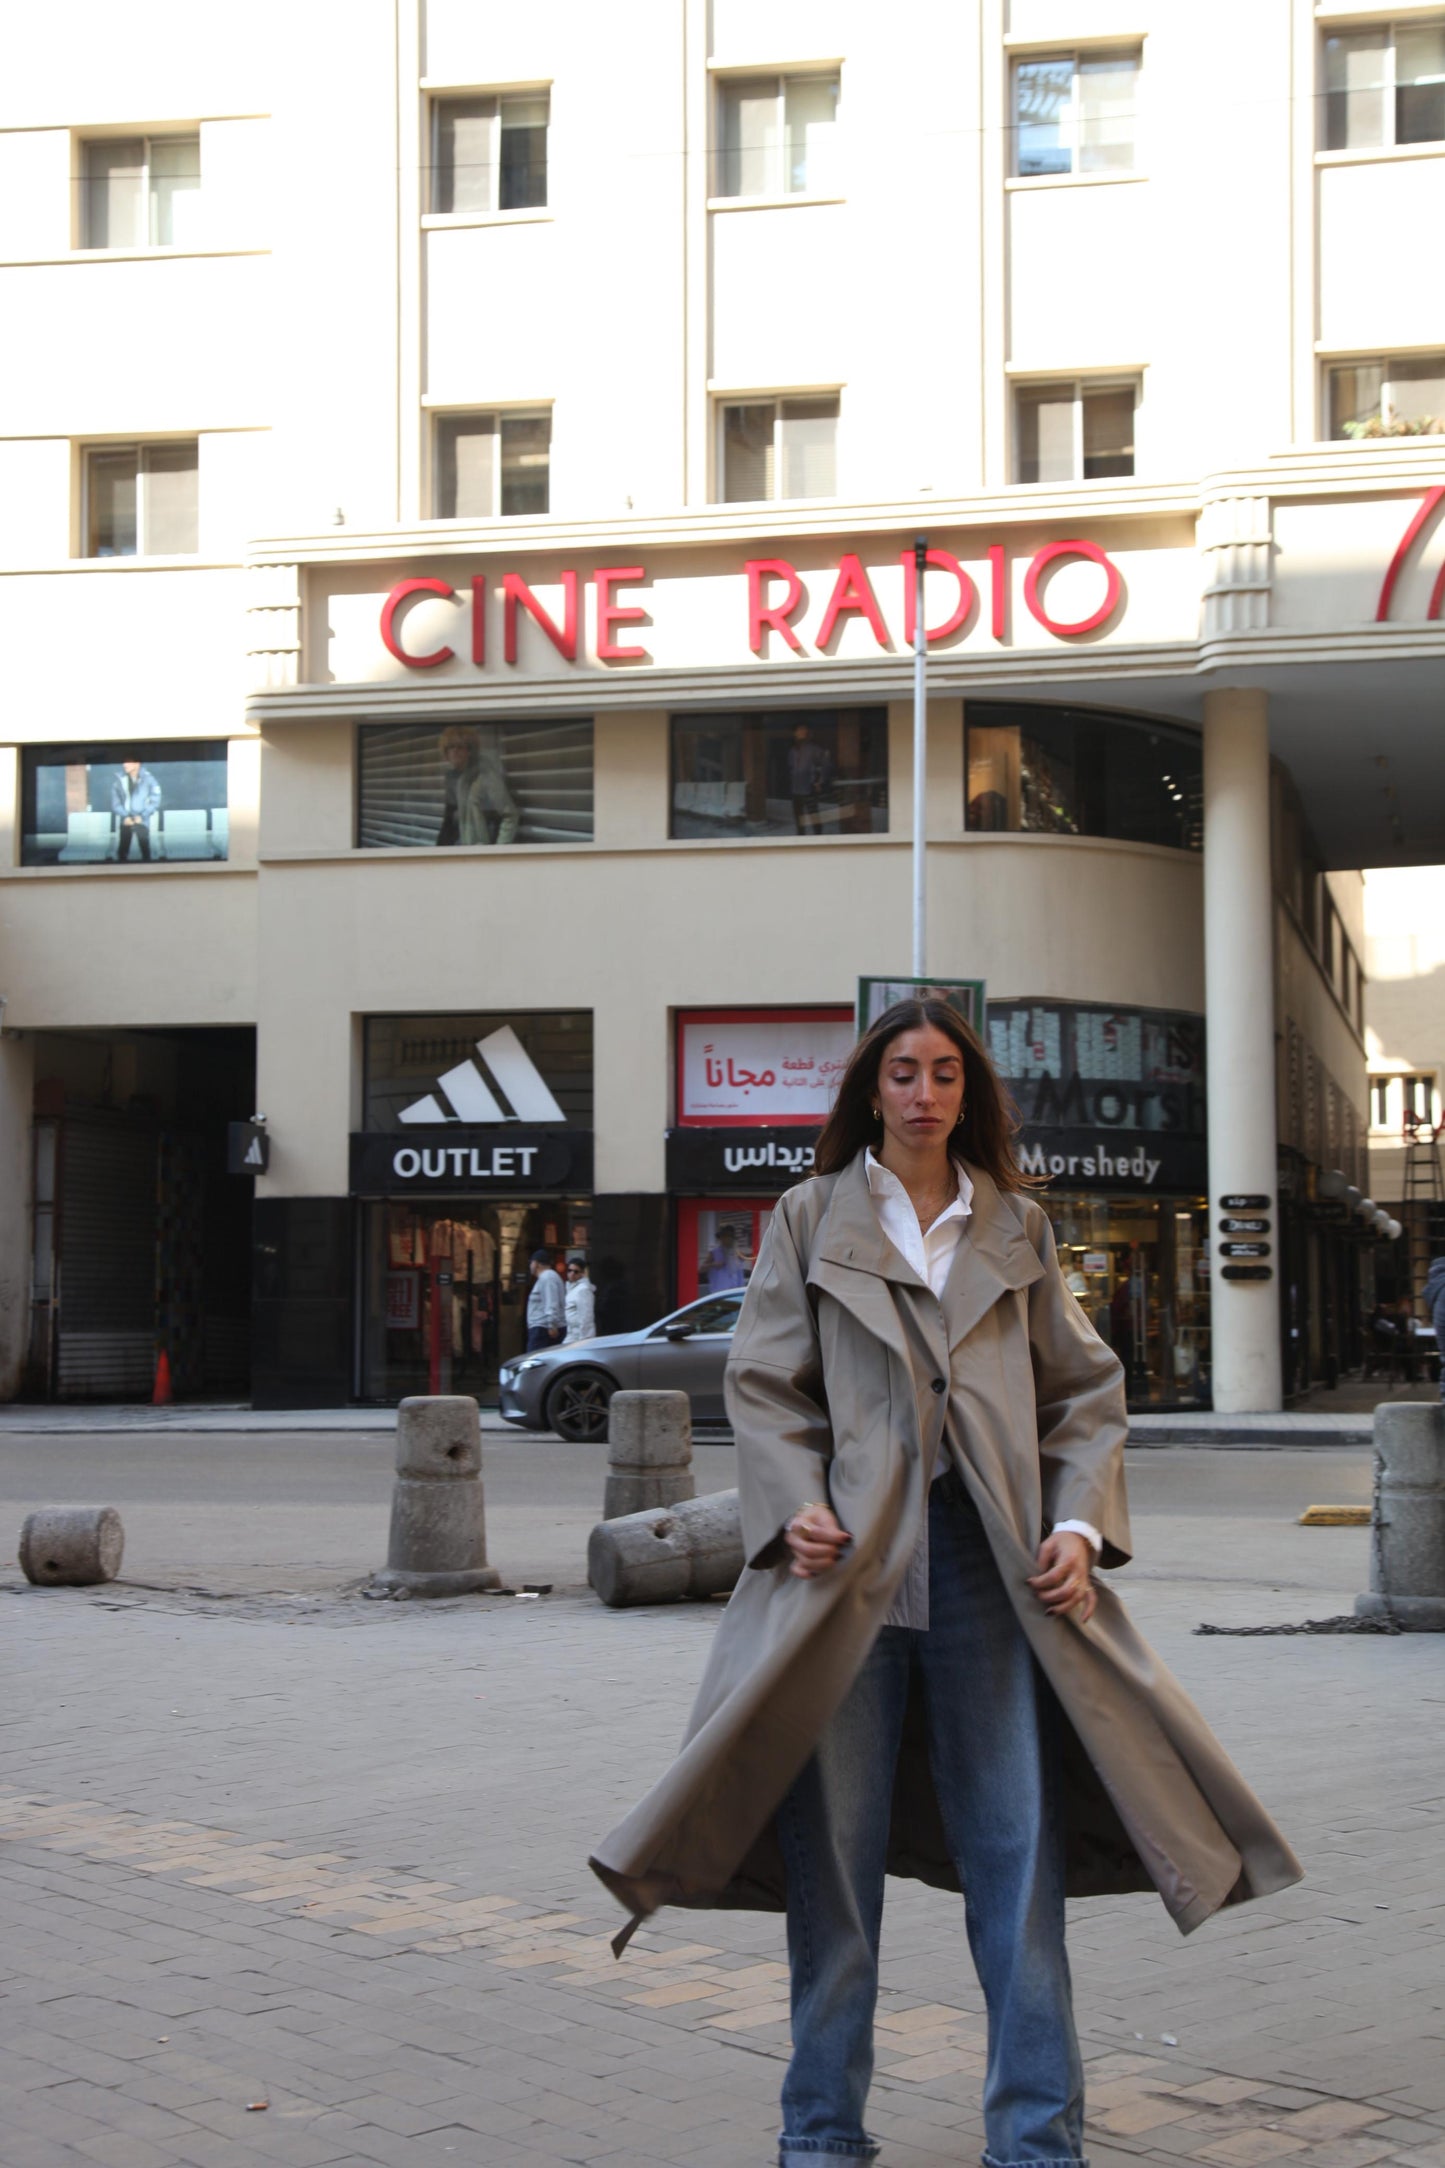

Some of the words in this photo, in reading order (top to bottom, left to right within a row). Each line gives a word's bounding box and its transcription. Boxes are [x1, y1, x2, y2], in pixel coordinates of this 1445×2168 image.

[379, 566, 646, 669] CINE
[743, 538, 1122, 653] RADIO
[392, 1146, 539, 1178] OUTLET
[724, 1142, 816, 1173] ديداس
[1018, 1142, 1161, 1184] Morshedy
